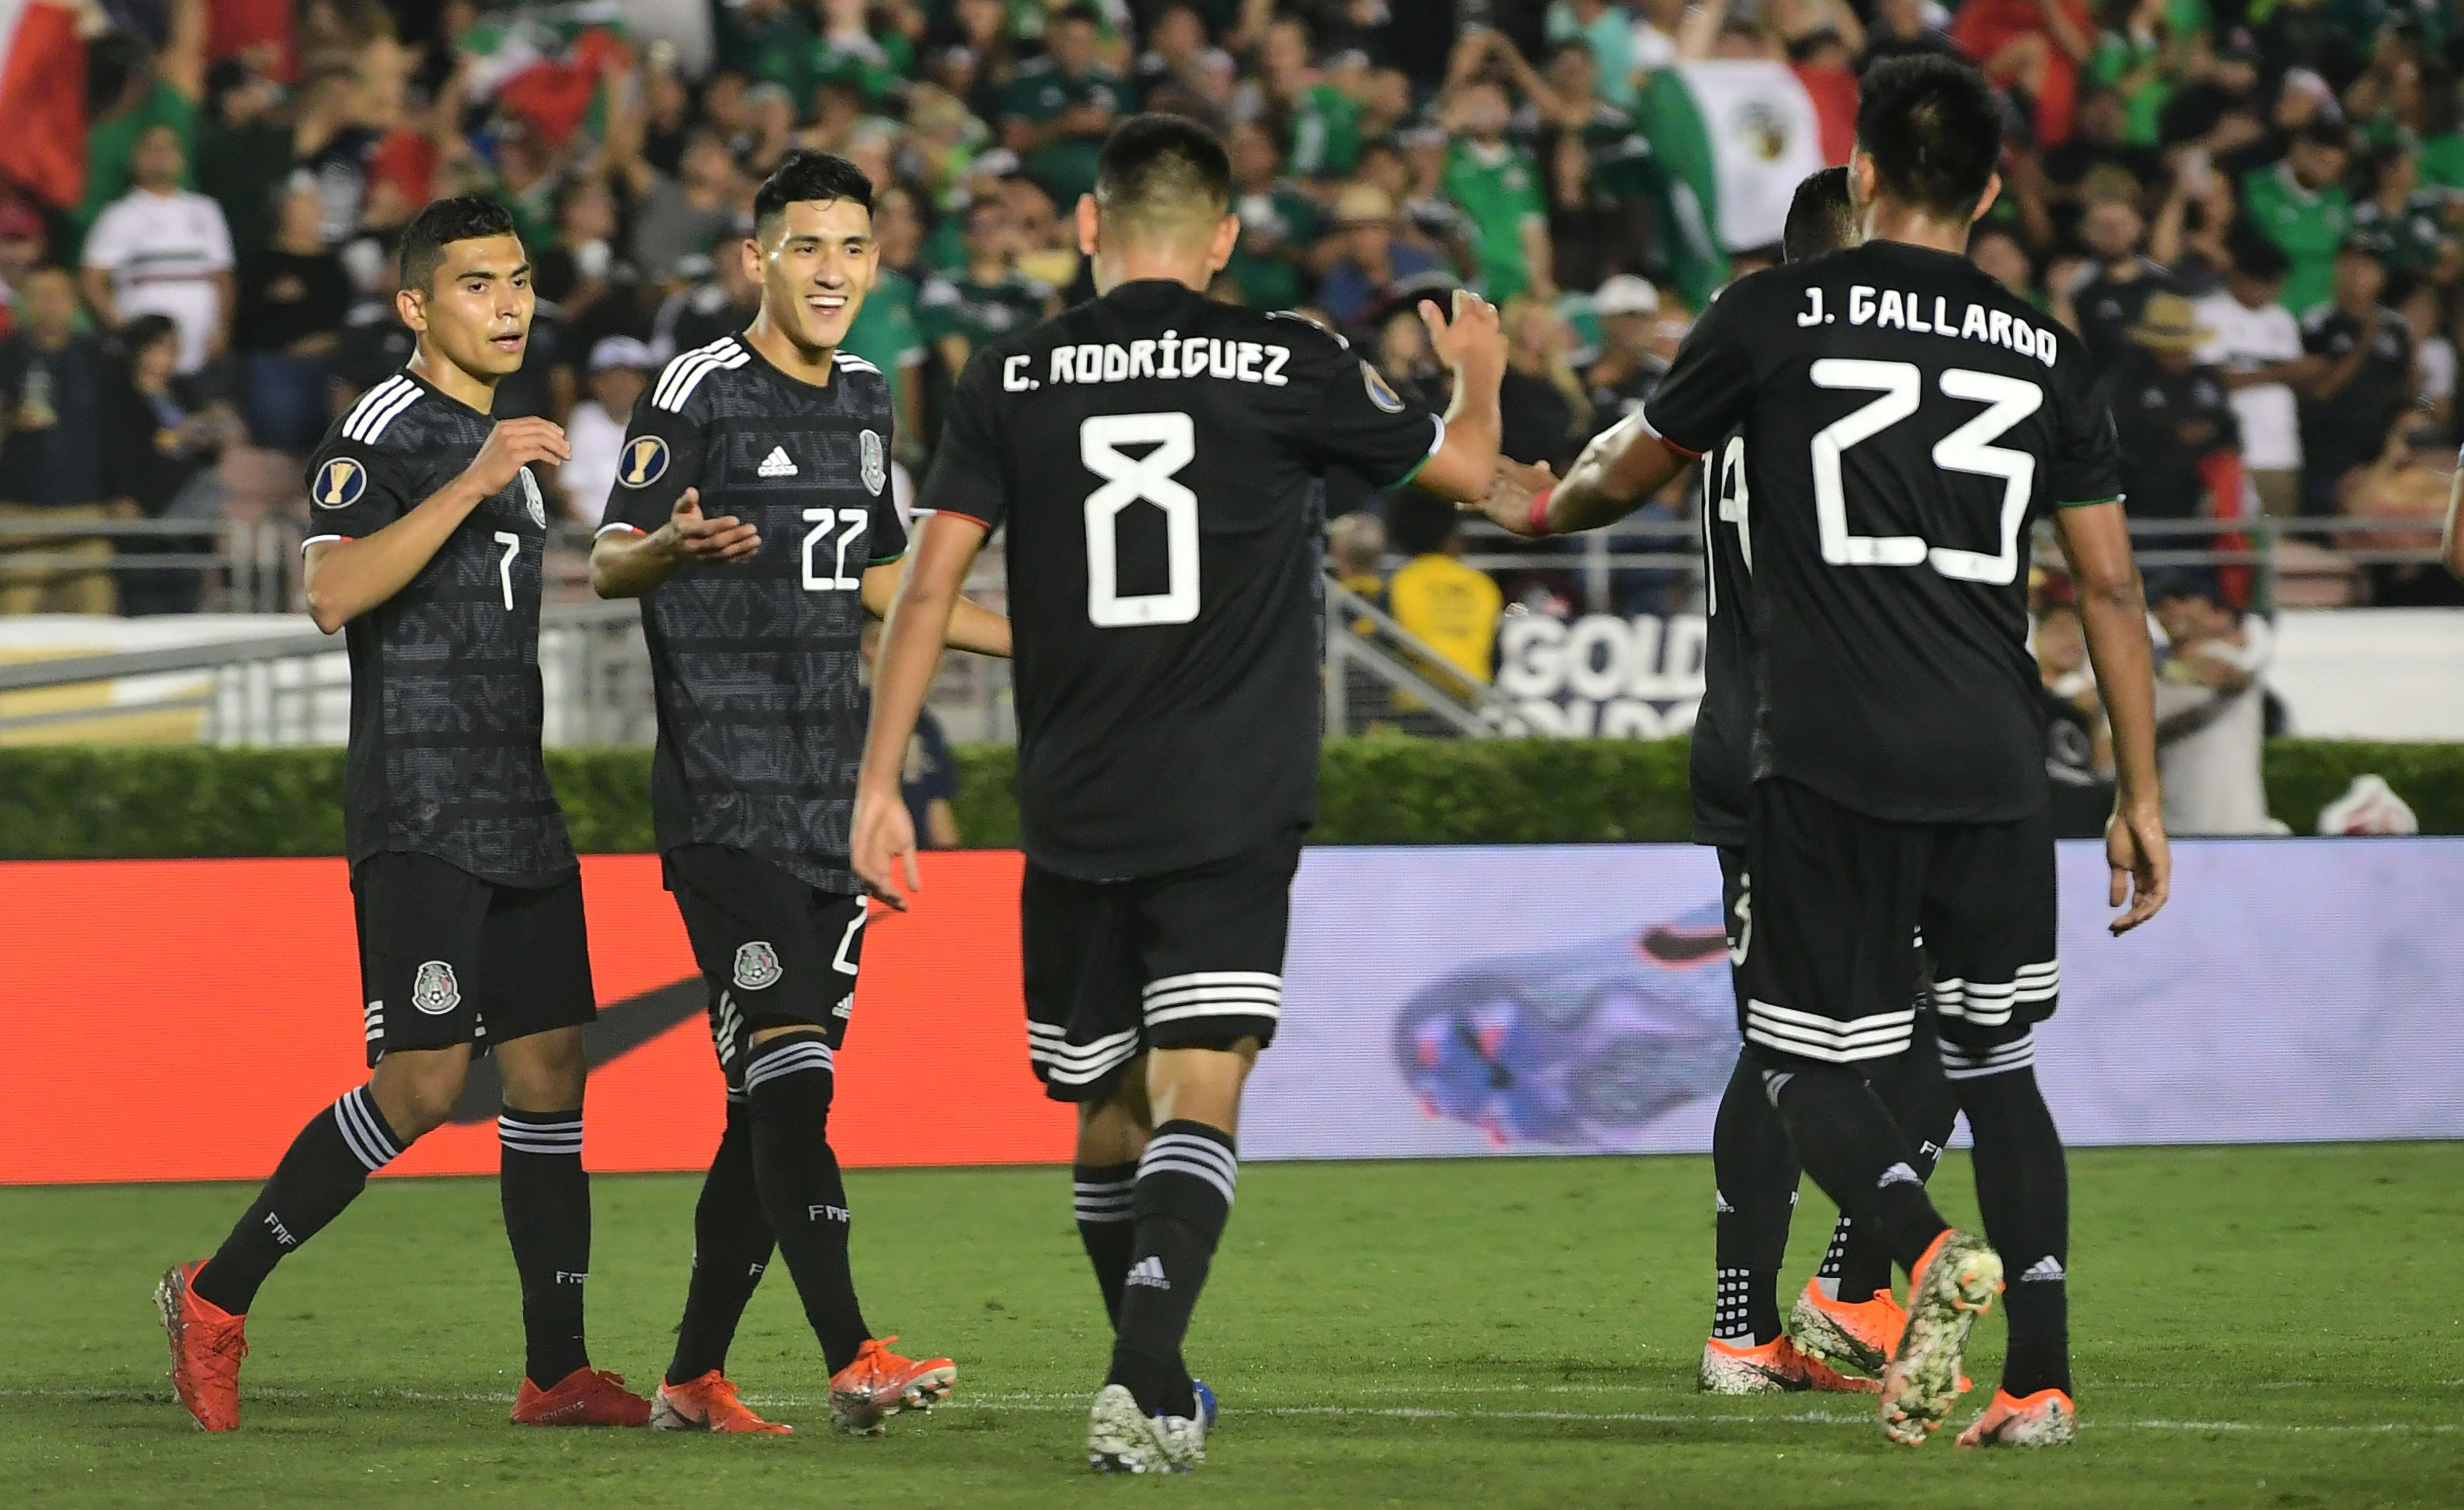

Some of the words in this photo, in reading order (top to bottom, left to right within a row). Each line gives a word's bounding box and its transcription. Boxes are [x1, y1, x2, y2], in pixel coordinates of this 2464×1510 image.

[1797, 287, 1835, 327] J.
[1850, 285, 2057, 368] GALLARDO
[1004, 355, 1040, 392] C.
[1810, 358, 2044, 586] 23
[802, 508, 868, 591] 22
[1080, 412, 1201, 628] 8
[494, 531, 519, 611] 7
[264, 1212, 297, 1245] FMF
[808, 1205, 850, 1223] FMF
